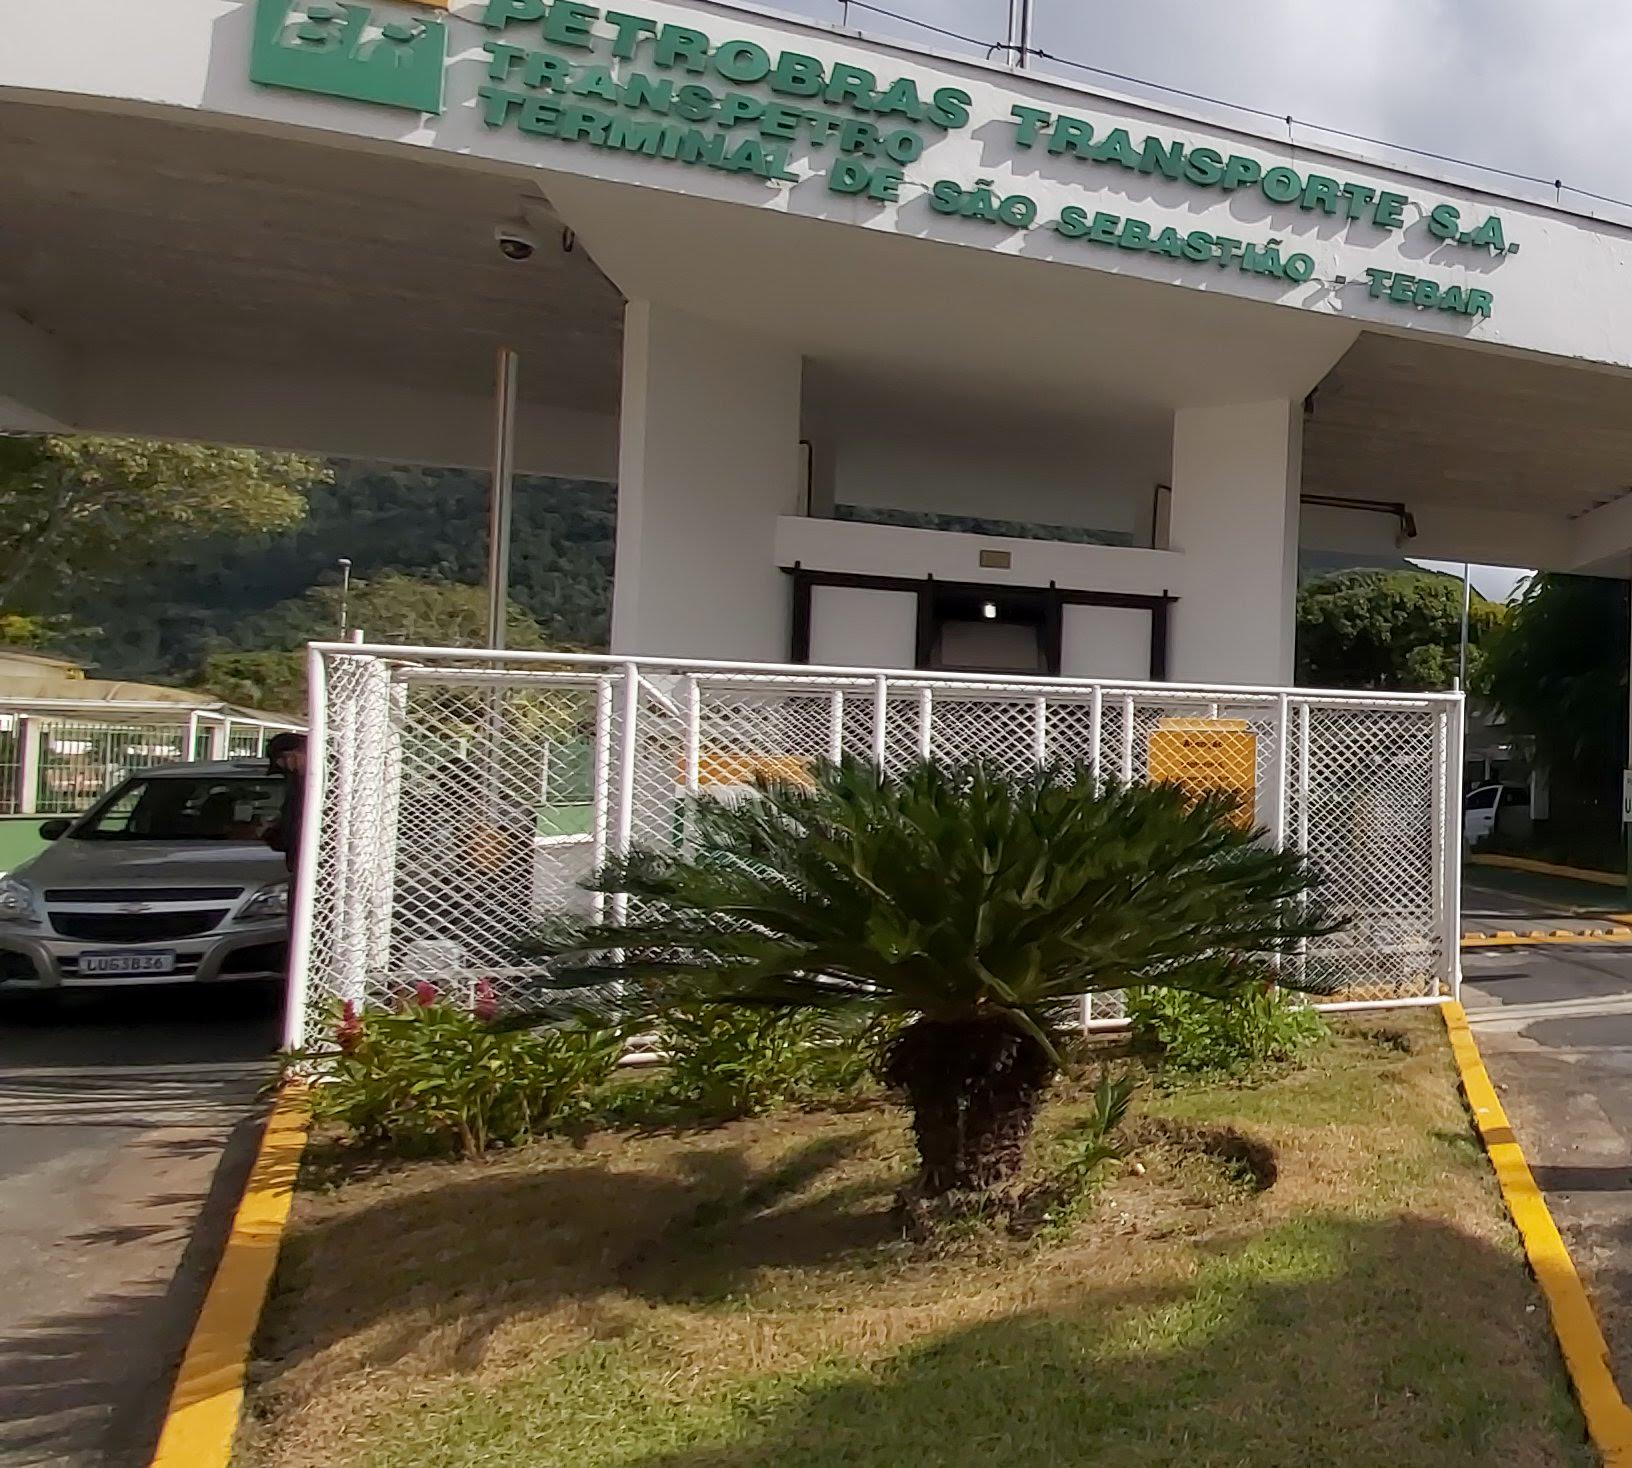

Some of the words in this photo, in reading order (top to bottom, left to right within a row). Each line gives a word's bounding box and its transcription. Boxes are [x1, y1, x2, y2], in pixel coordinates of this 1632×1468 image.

[478, 85, 800, 183] TERMINAL
[828, 157, 905, 202] DE
[929, 179, 1037, 230] SÃO
[1056, 205, 1315, 283] SEBASTIÃO
[1366, 267, 1494, 318] TEBAR
[483, 41, 923, 165] TRANSPETRO
[484, 0, 972, 129] PETROBRAS
[1010, 104, 1409, 229] TRANSPORTE
[1427, 204, 1520, 254] S.A.
